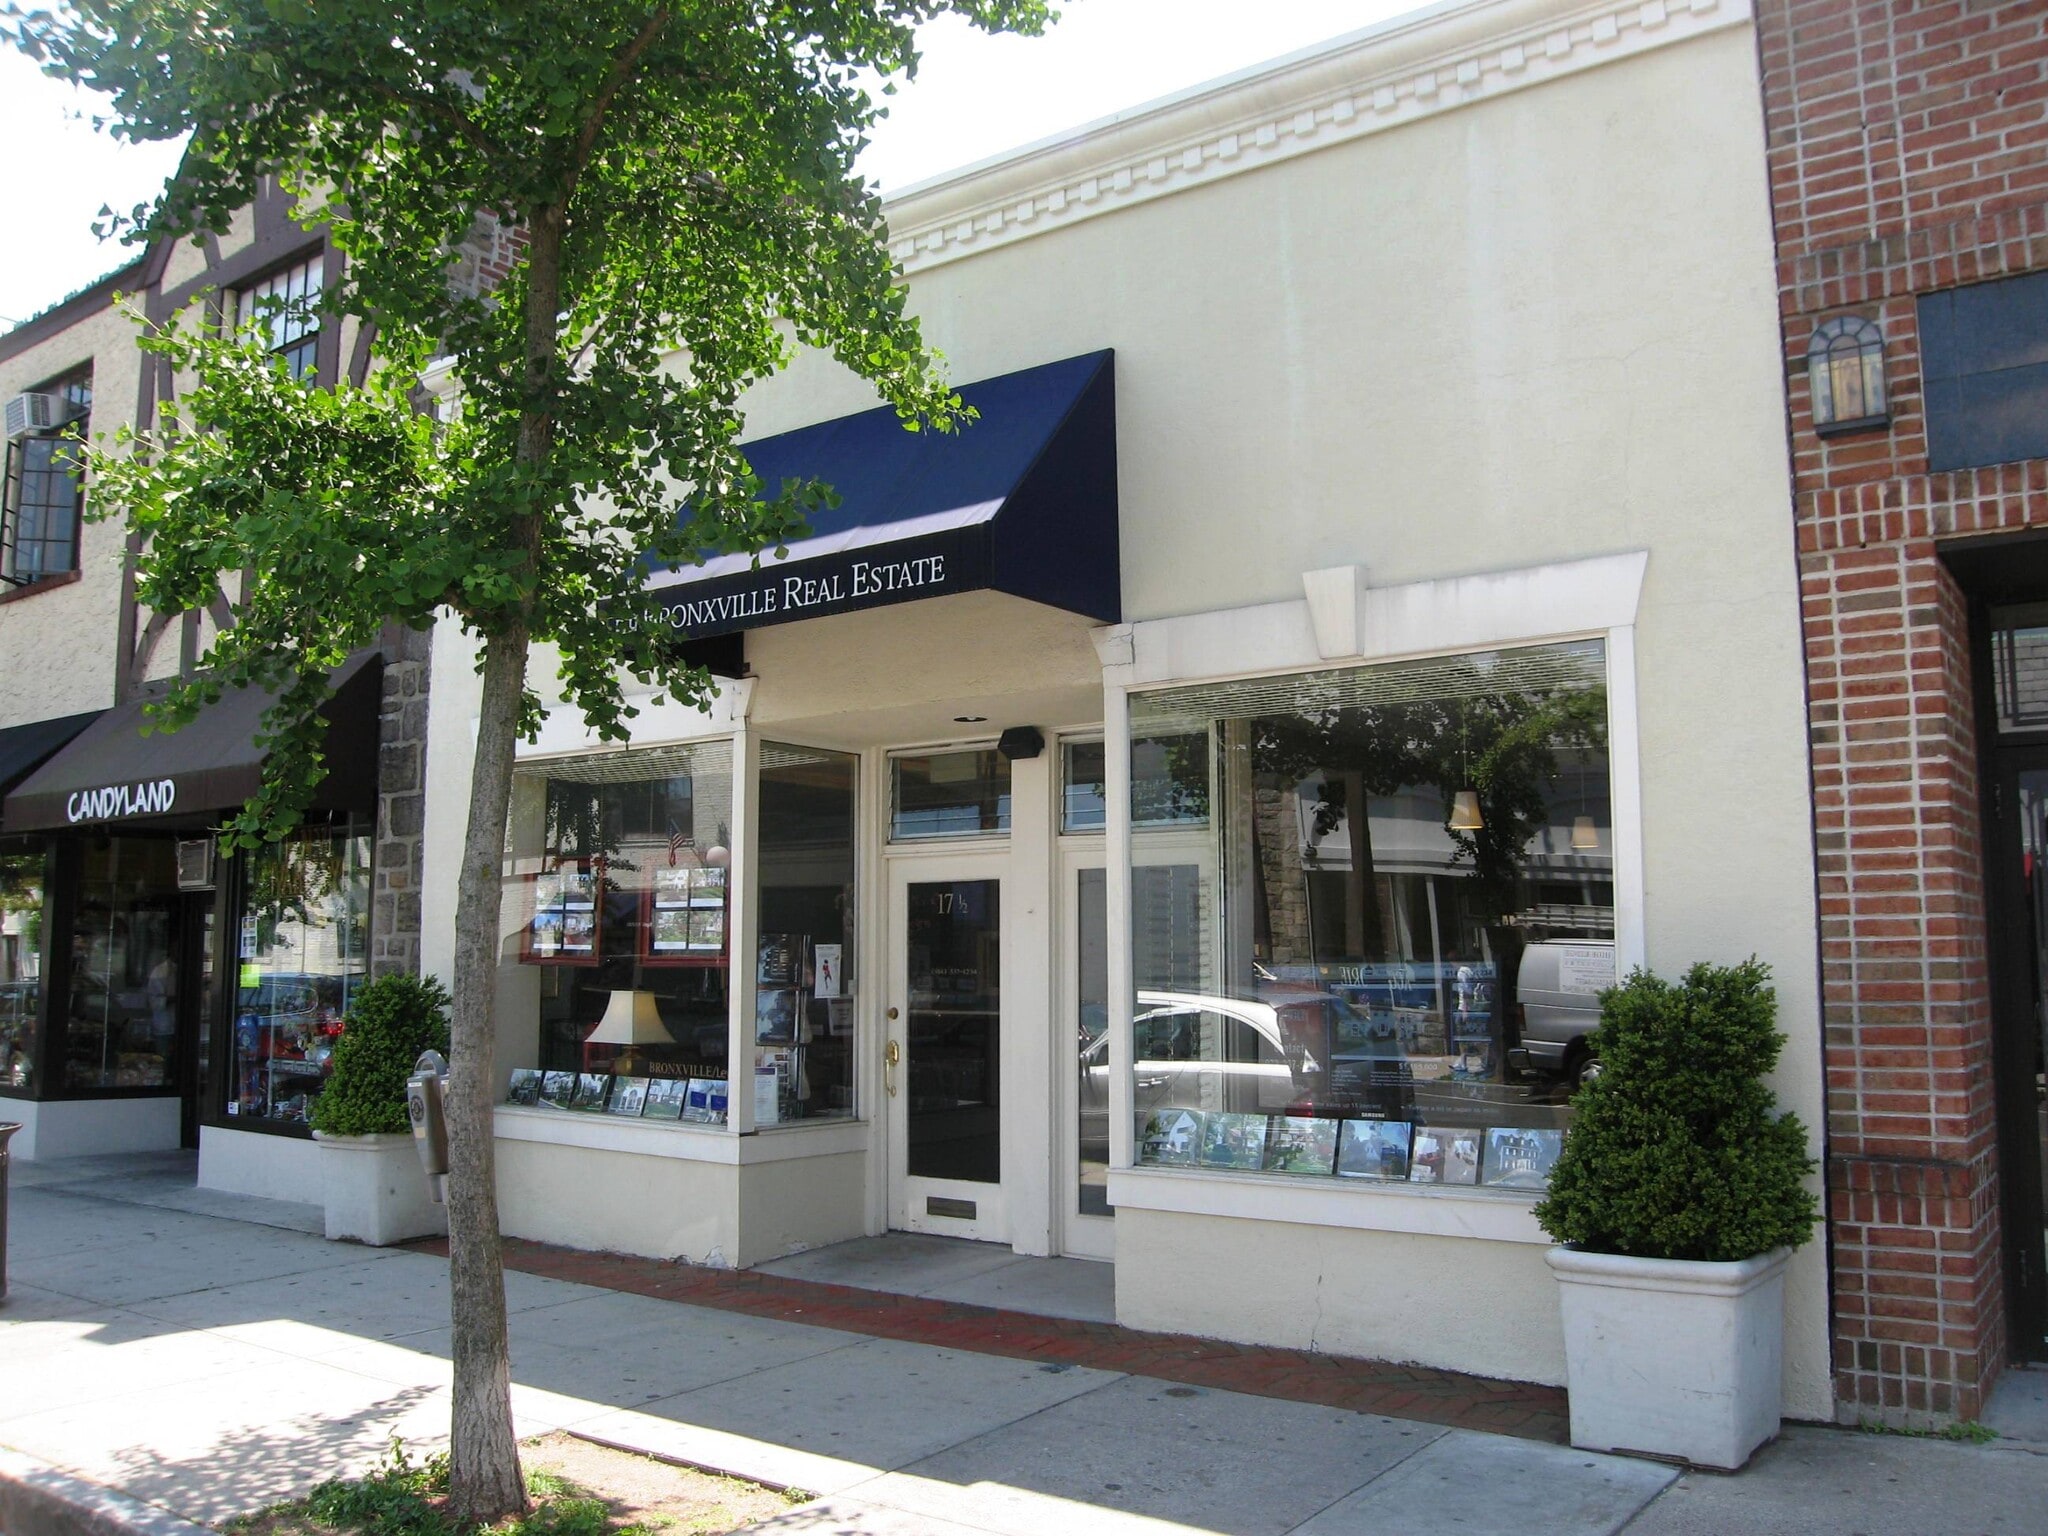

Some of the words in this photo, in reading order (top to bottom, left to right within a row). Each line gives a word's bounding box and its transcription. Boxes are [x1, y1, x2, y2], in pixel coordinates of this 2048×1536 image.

[782, 575, 846, 610] REAL
[851, 555, 946, 598] ESTATE
[67, 779, 175, 823] CANDYLAND
[938, 893, 954, 914] 17
